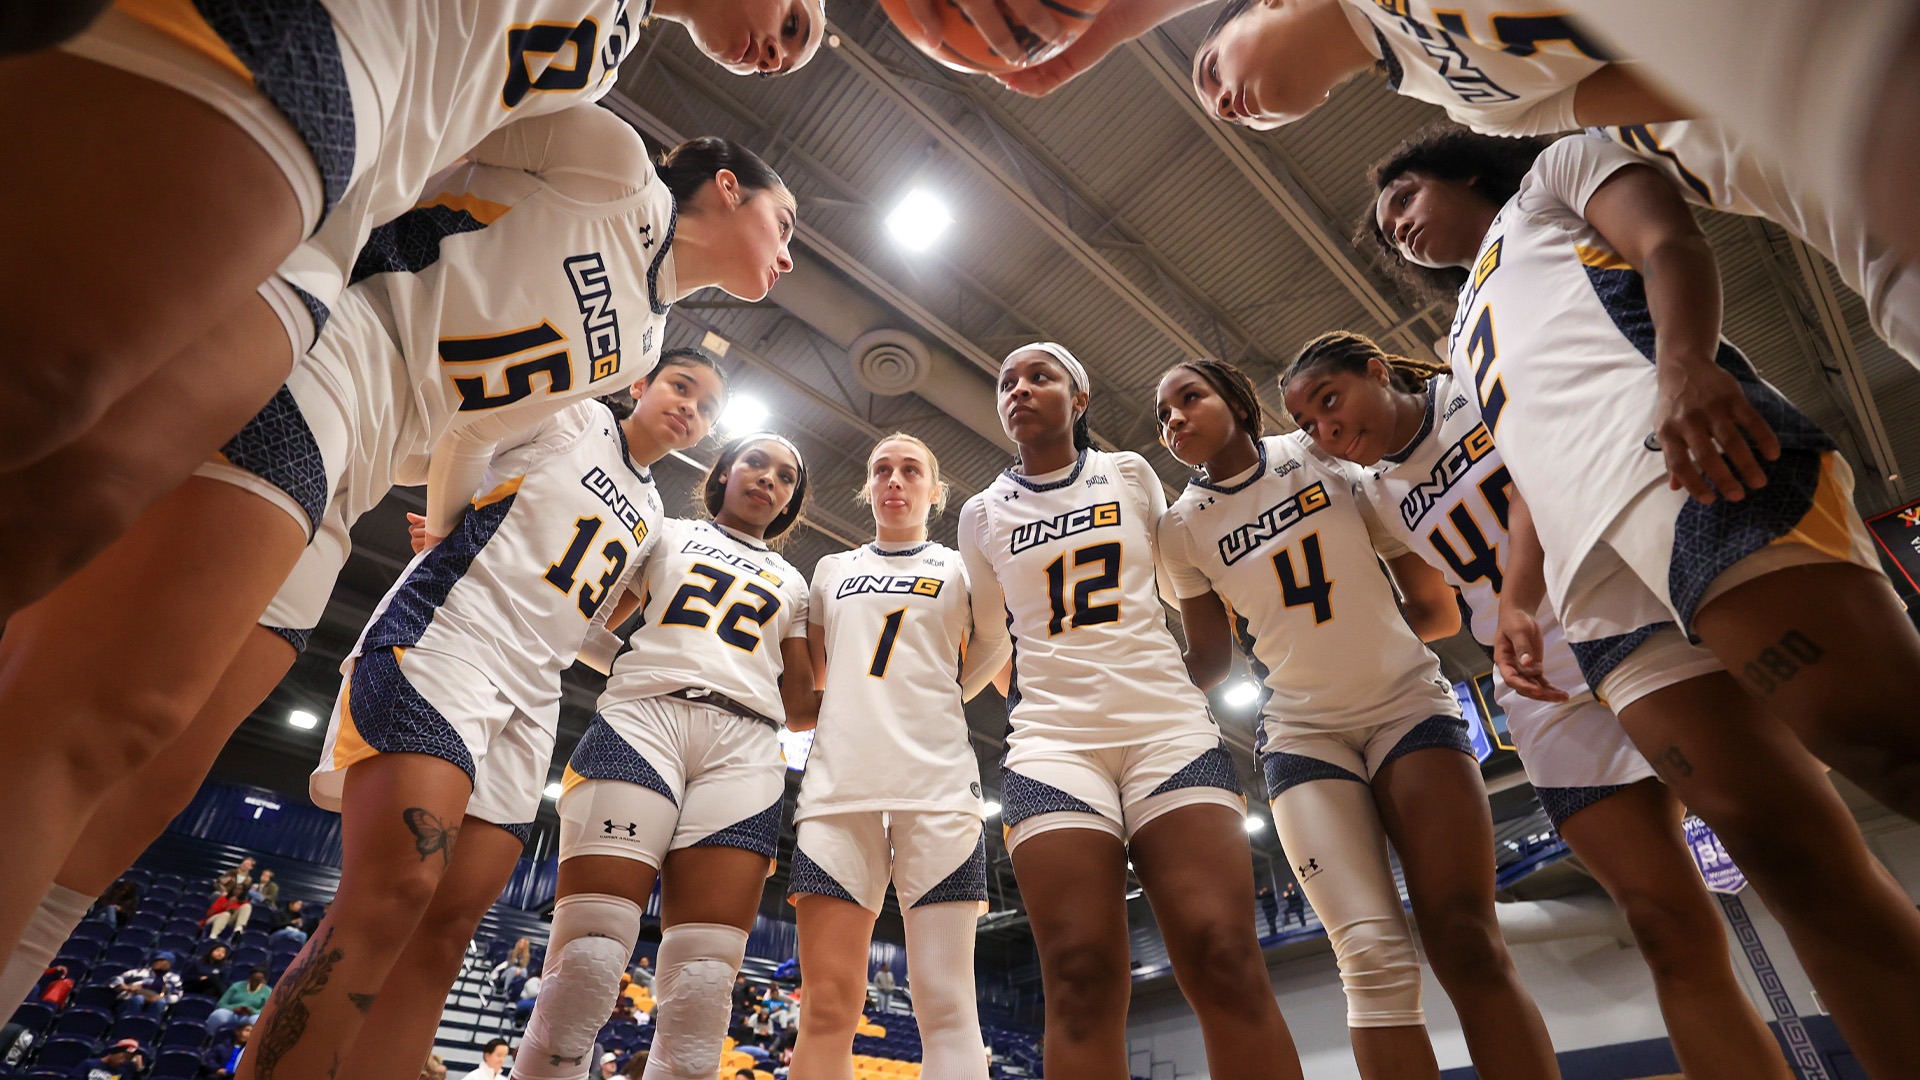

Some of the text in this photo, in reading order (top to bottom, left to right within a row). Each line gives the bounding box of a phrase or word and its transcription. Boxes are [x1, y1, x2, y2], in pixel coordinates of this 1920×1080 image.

[438, 316, 574, 413] 15
[563, 252, 622, 384] UNCG
[1466, 301, 1511, 440] 2
[581, 466, 649, 548] UNCG
[1218, 480, 1331, 567] UNCG
[1400, 420, 1496, 532] UNCG
[541, 513, 629, 622] 13
[680, 540, 784, 589] UNCG
[1010, 501, 1121, 556] UNCG
[658, 562, 782, 655] 22
[836, 575, 945, 600] UNCG
[1042, 539, 1124, 640] 12
[1270, 529, 1336, 628] 4
[867, 605, 908, 680] 1
